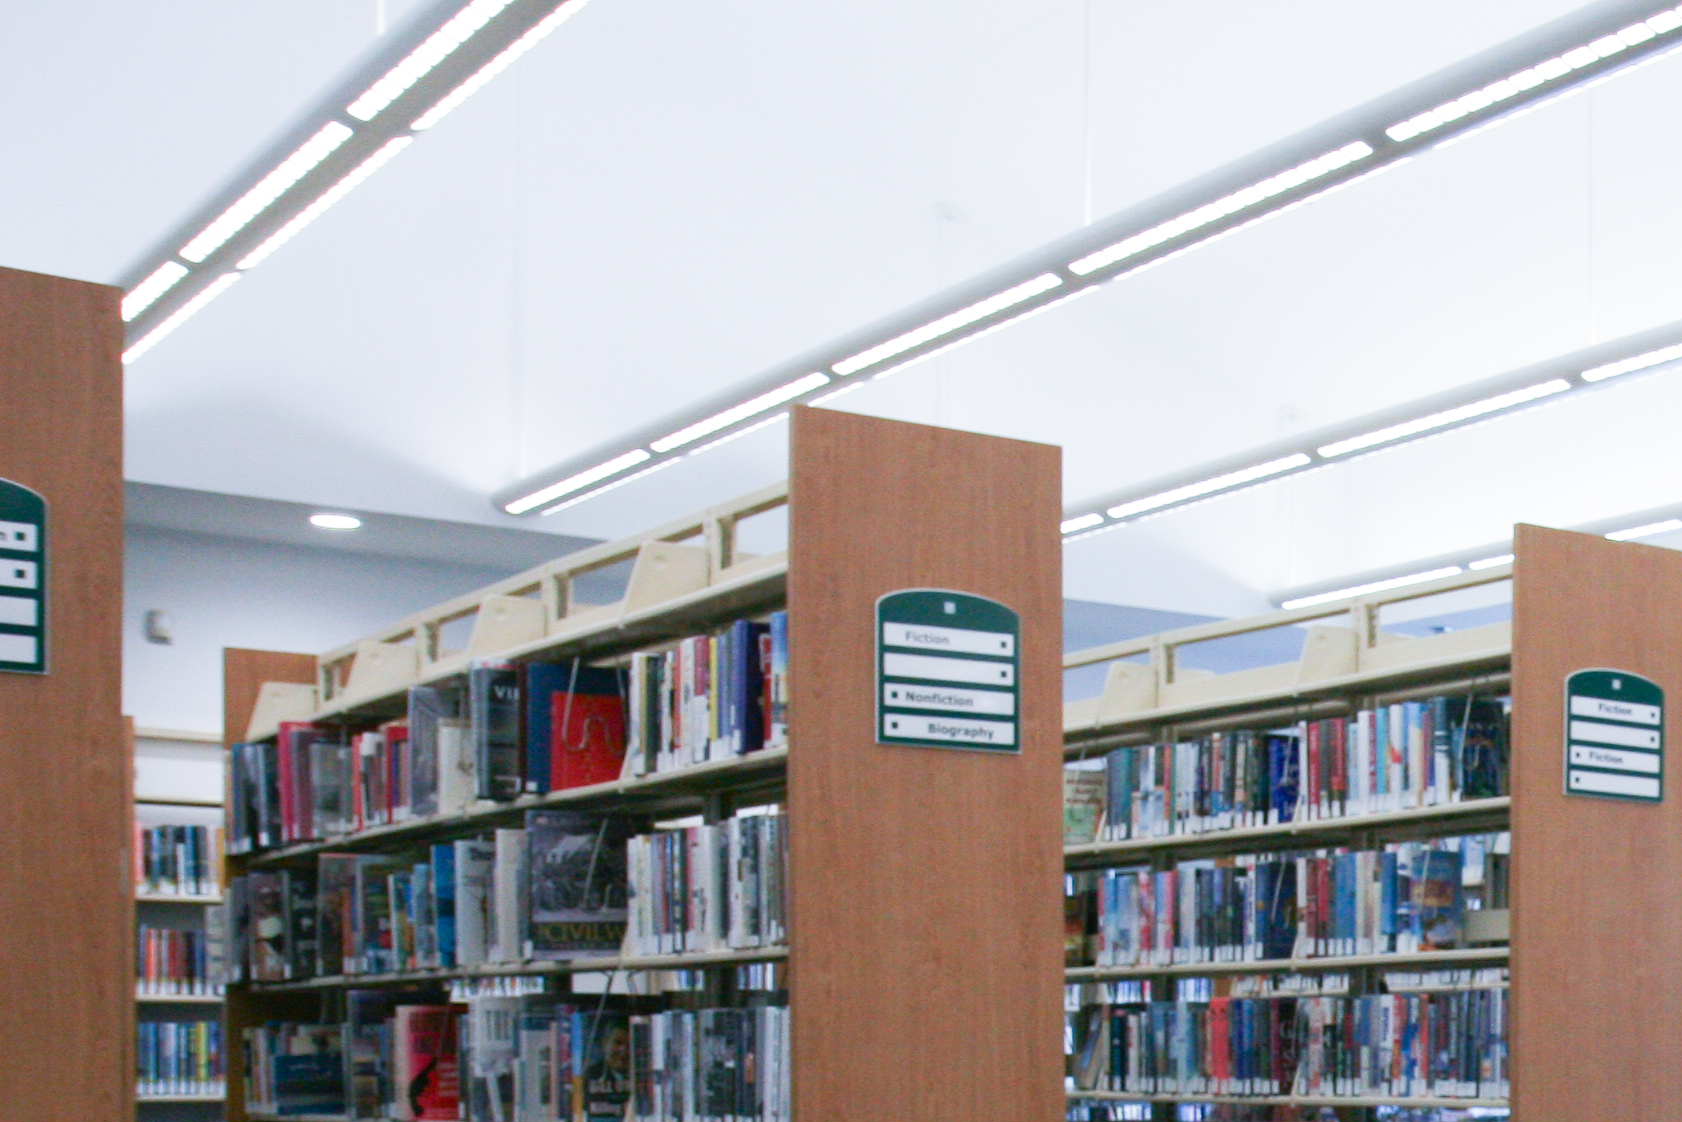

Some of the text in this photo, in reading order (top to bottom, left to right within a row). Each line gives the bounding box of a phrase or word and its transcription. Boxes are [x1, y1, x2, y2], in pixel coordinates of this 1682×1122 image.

[905, 631, 949, 644] Fiction
[905, 692, 974, 706] Nonfiction
[1598, 703, 1633, 715] Fiction
[928, 723, 994, 740] Biography
[1589, 751, 1623, 764] Fiction
